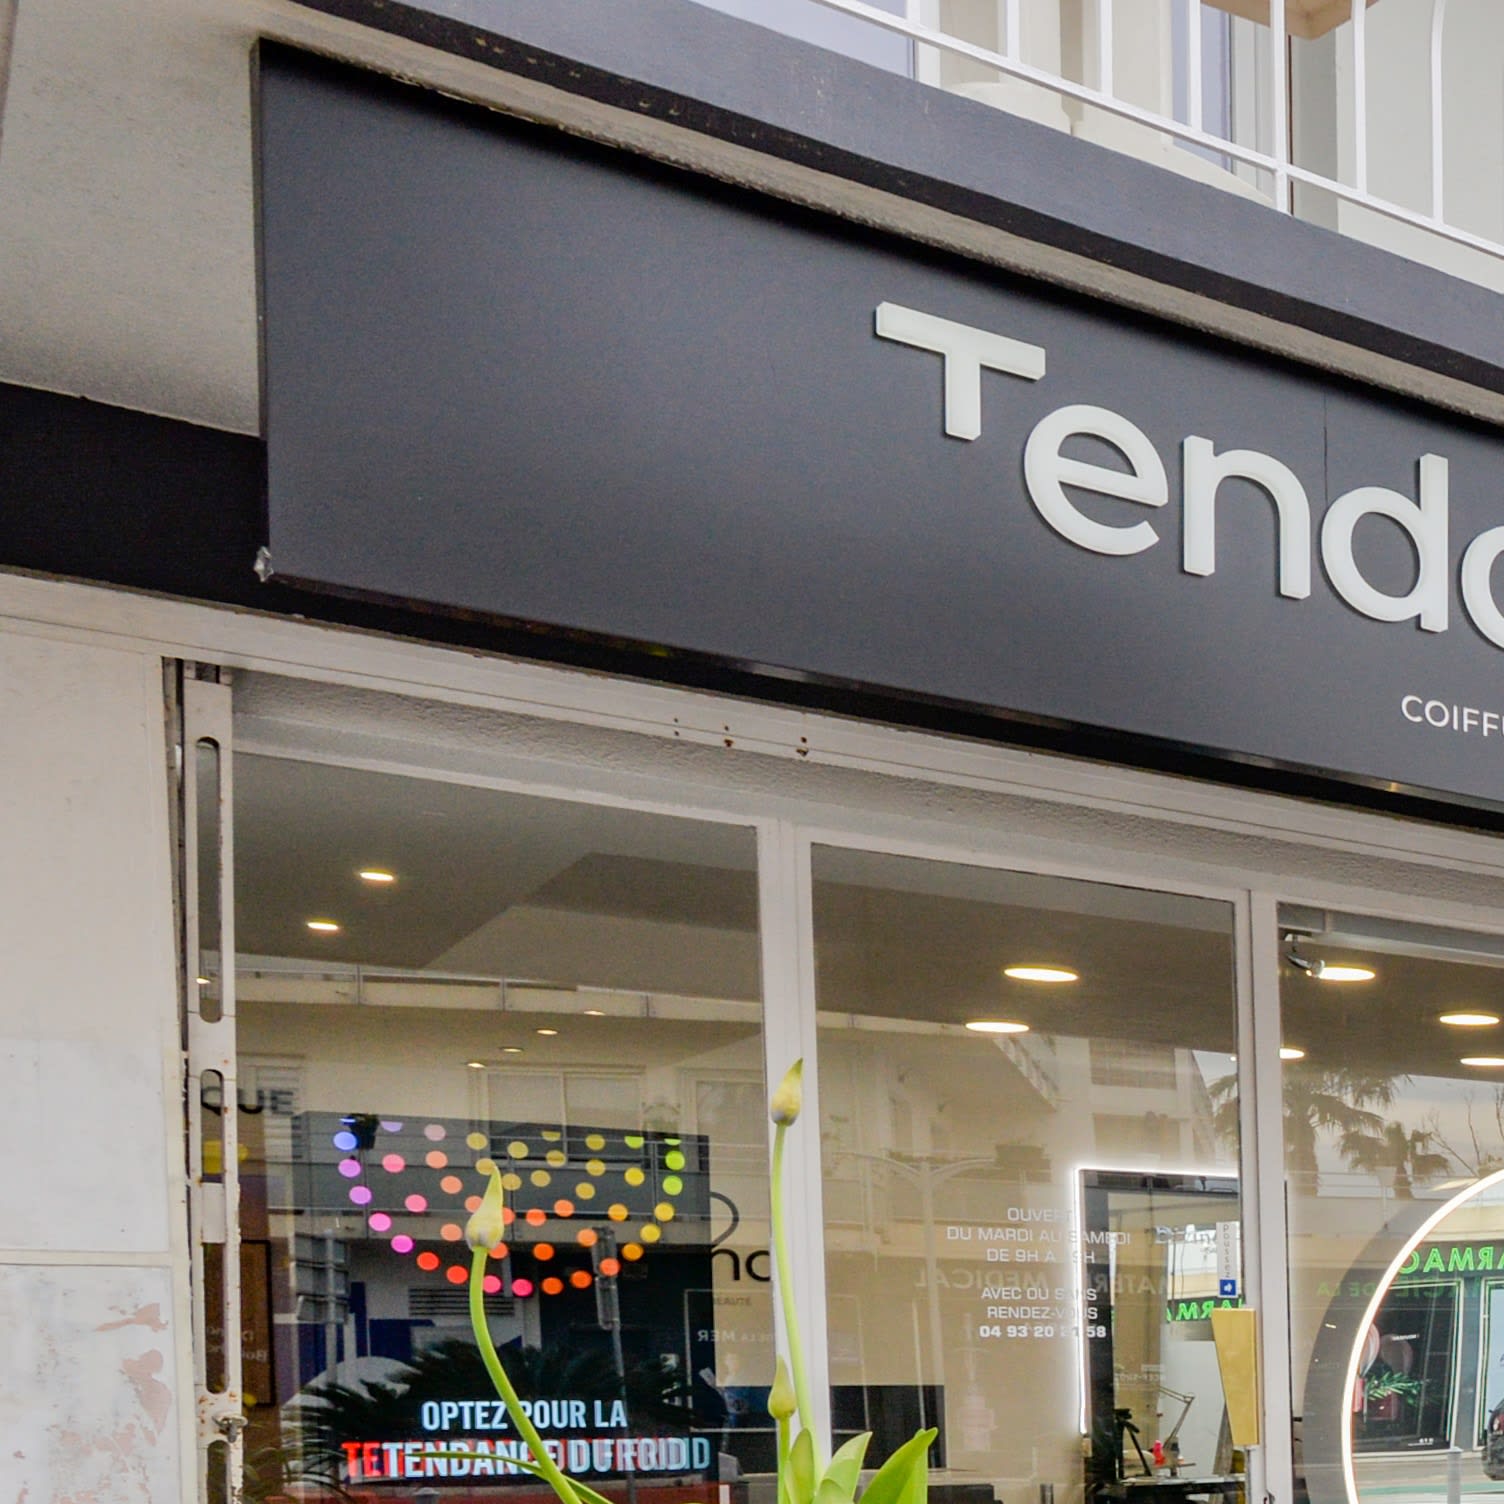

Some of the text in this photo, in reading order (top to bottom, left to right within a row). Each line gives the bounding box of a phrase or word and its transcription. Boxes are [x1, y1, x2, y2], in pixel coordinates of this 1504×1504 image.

[946, 1226, 971, 1240] DU
[978, 1227, 1033, 1241] MARDI
[1039, 1229, 1062, 1242] AU
[987, 1248, 1010, 1262] DE
[1015, 1249, 1039, 1262] 9H
[981, 1287, 1097, 1301] AVEC OU SS
[987, 1306, 1098, 1320] RENDEZ-VS
[979, 1326, 1002, 1338] 04
[1007, 1326, 1028, 1338] 93
[1034, 1326, 1054, 1338] 20
[1087, 1326, 1107, 1338] 58
[420, 1400, 509, 1431] OPTEZ
[594, 1399, 628, 1429] LA
